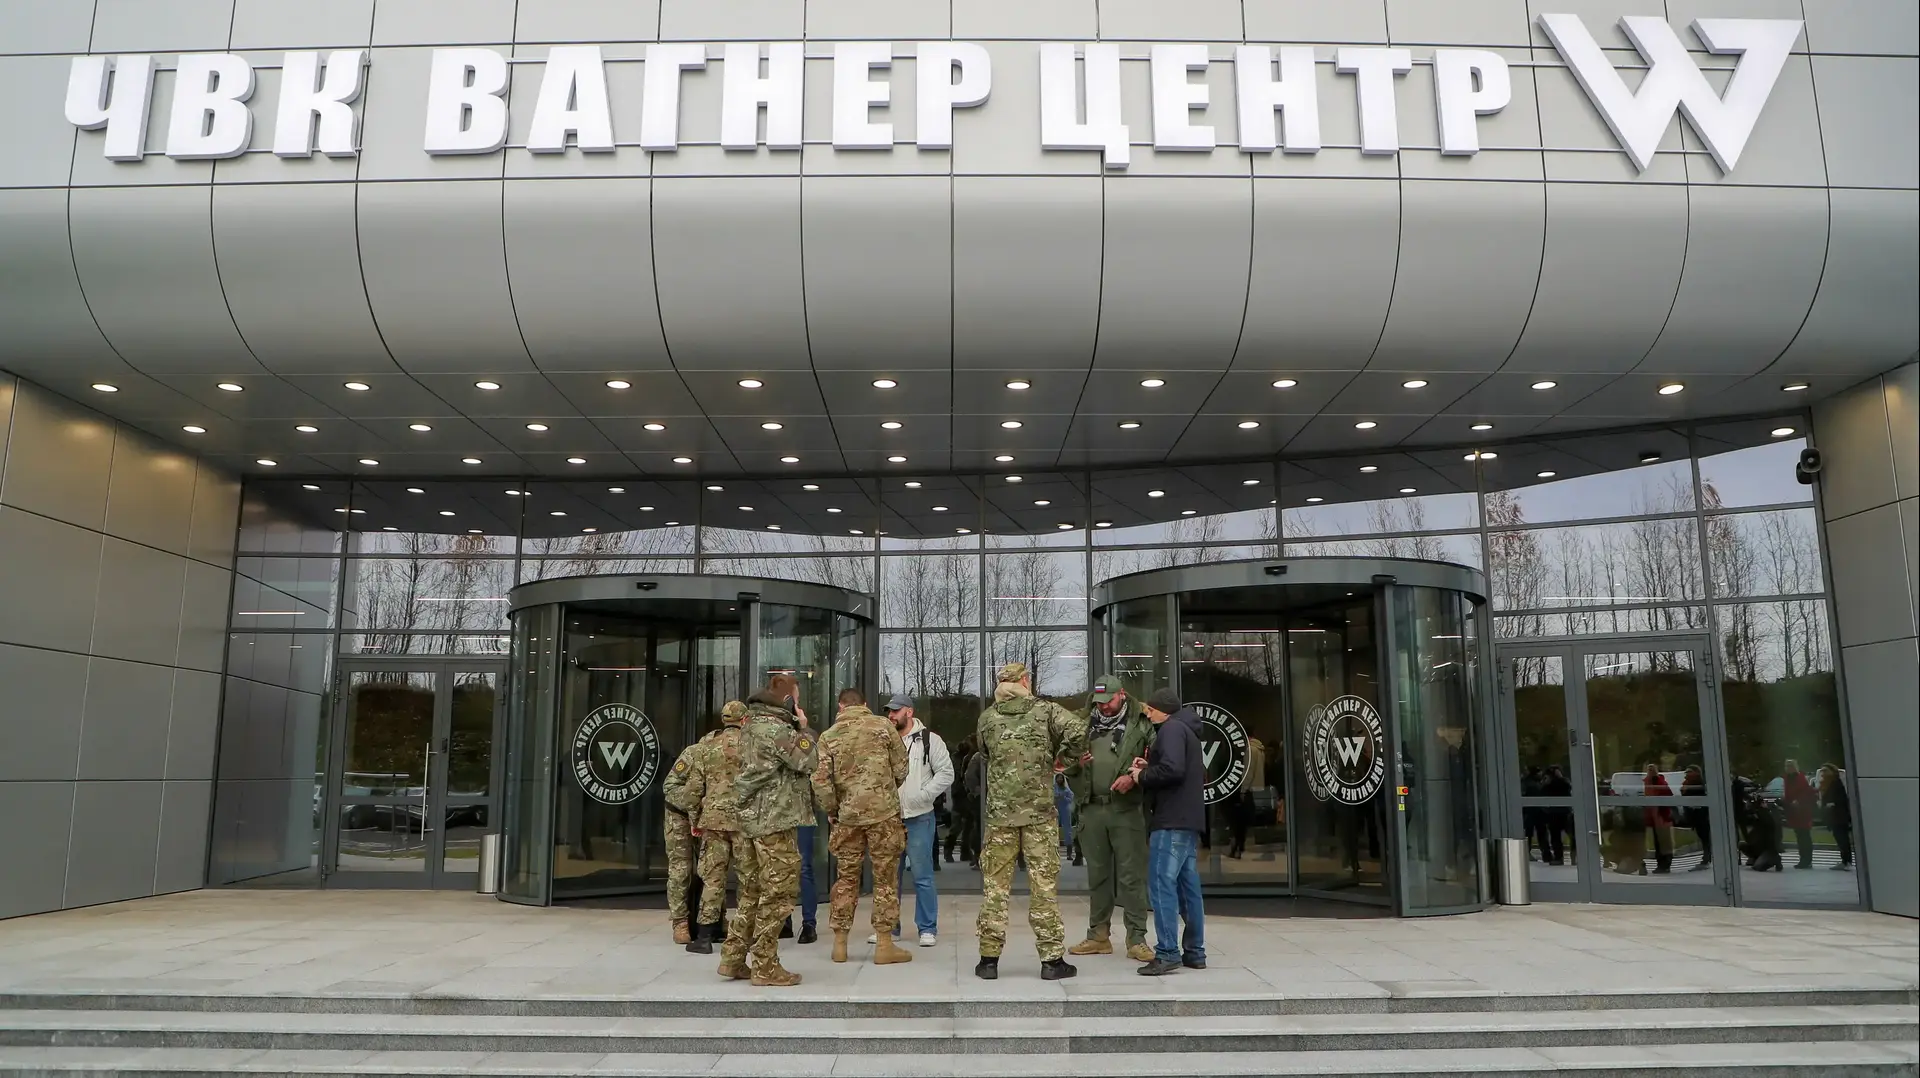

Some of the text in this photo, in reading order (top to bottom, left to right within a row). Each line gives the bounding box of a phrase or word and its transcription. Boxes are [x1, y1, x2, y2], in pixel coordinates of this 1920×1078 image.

[65, 42, 1512, 168] ЧВК ВАГНЕР ЦЕНТР
[1536, 13, 1804, 175] W
[1327, 699, 1361, 721] ВАГНЕР
[1333, 736, 1366, 767] W
[576, 760, 655, 801] ЧВК ВАГНЕР ЦЕНТР
[1217, 760, 1245, 795] ЦЕНТР
